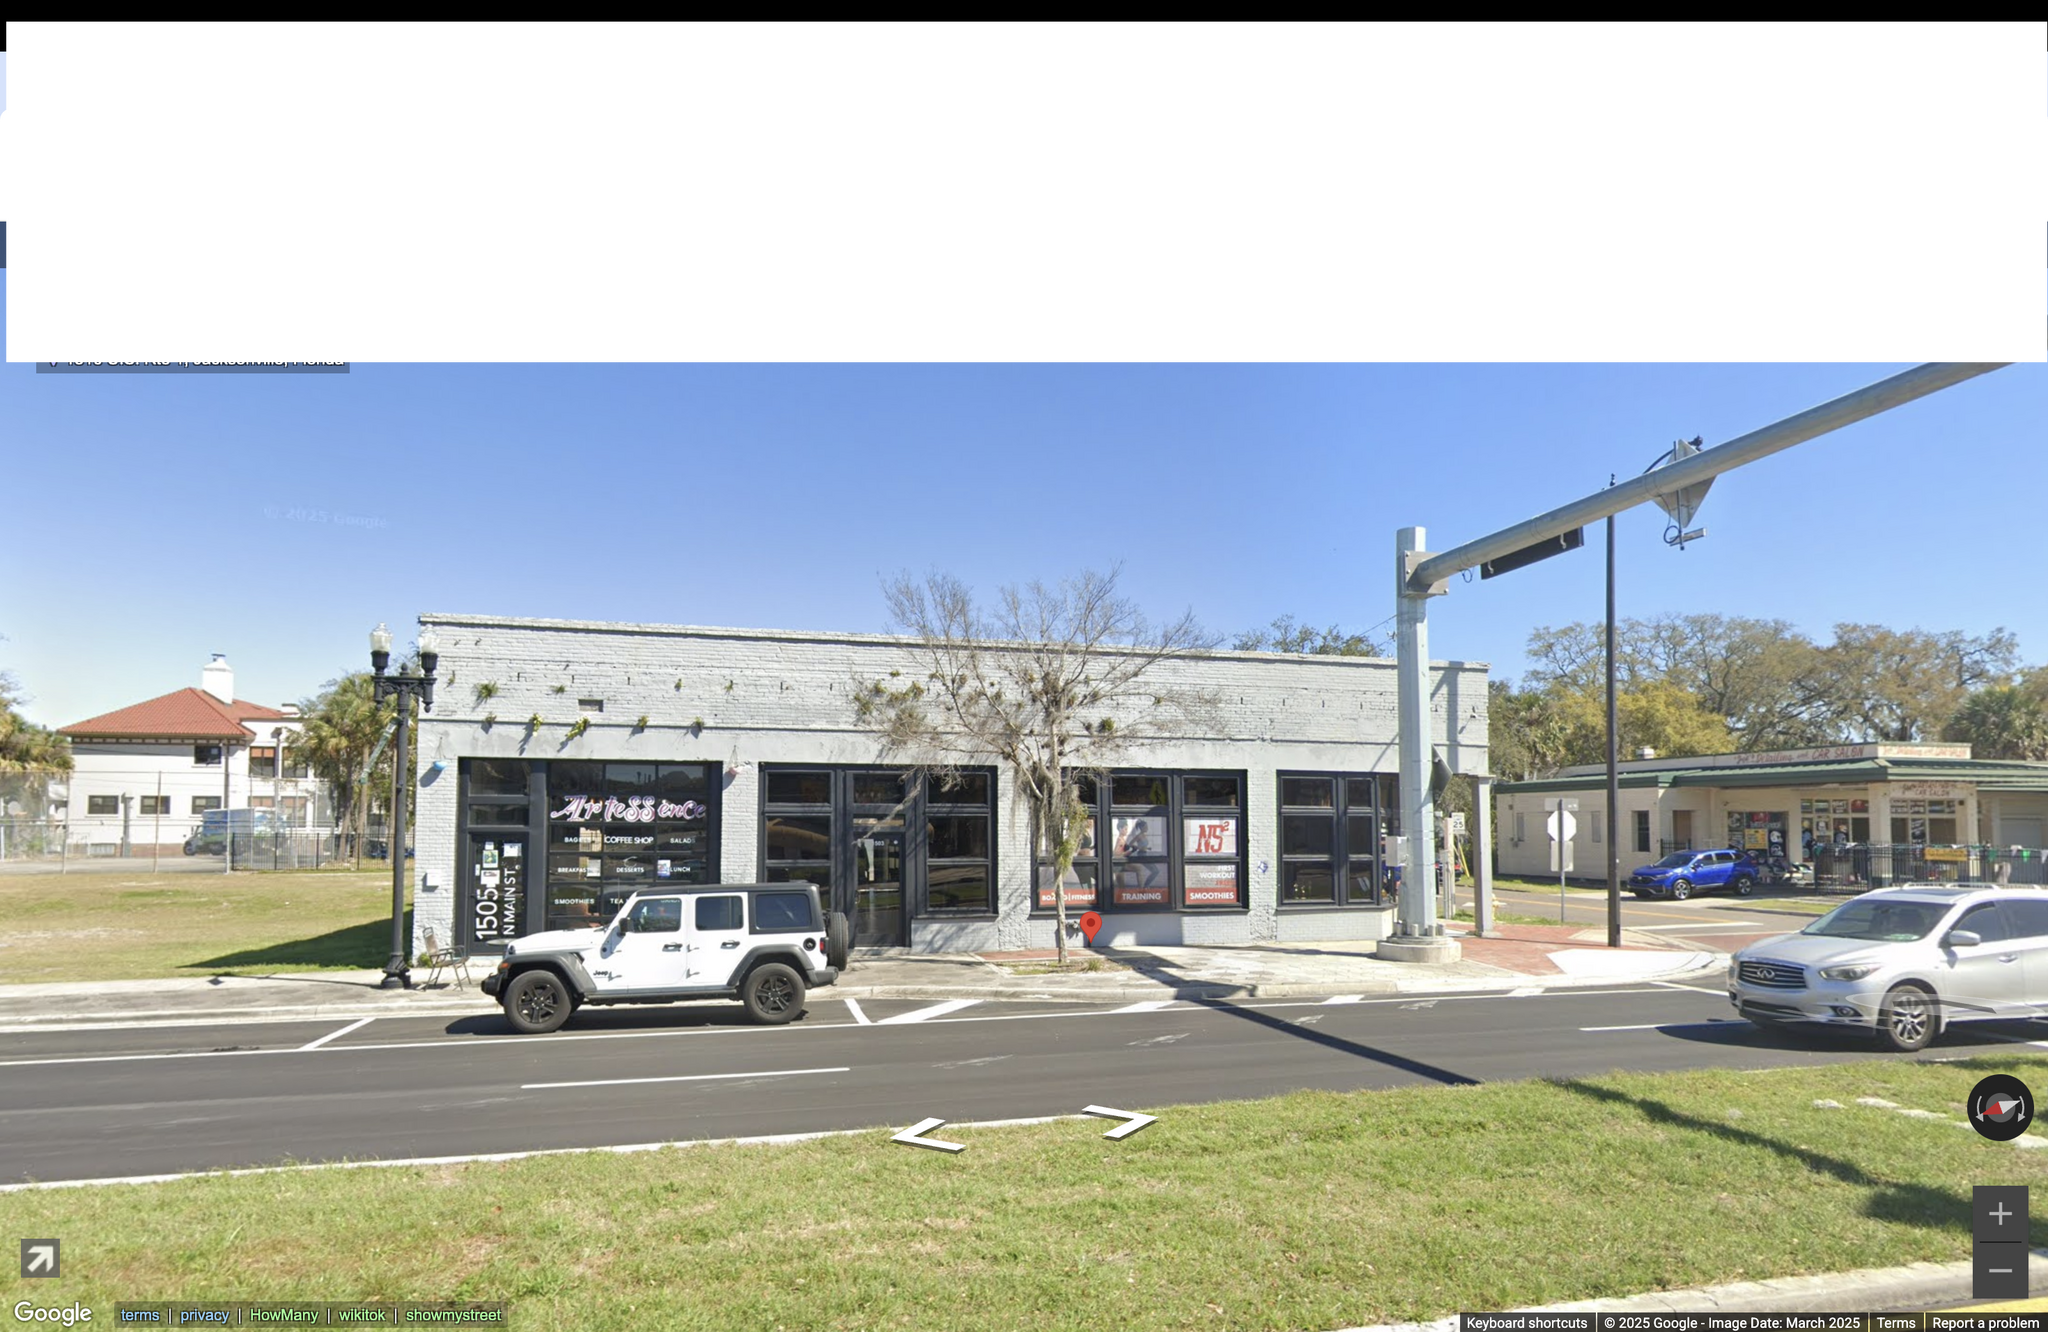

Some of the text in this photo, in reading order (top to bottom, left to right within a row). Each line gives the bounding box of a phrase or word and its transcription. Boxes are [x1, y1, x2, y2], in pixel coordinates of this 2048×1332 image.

[1453, 821, 1464, 829] 25
[604, 835, 654, 844] COFFEE SHOP
[1122, 892, 1162, 901] TRAINING
[1190, 892, 1235, 900] SMOOTHIES
[503, 887, 516, 922] MAIN
[475, 888, 499, 939] 1505
